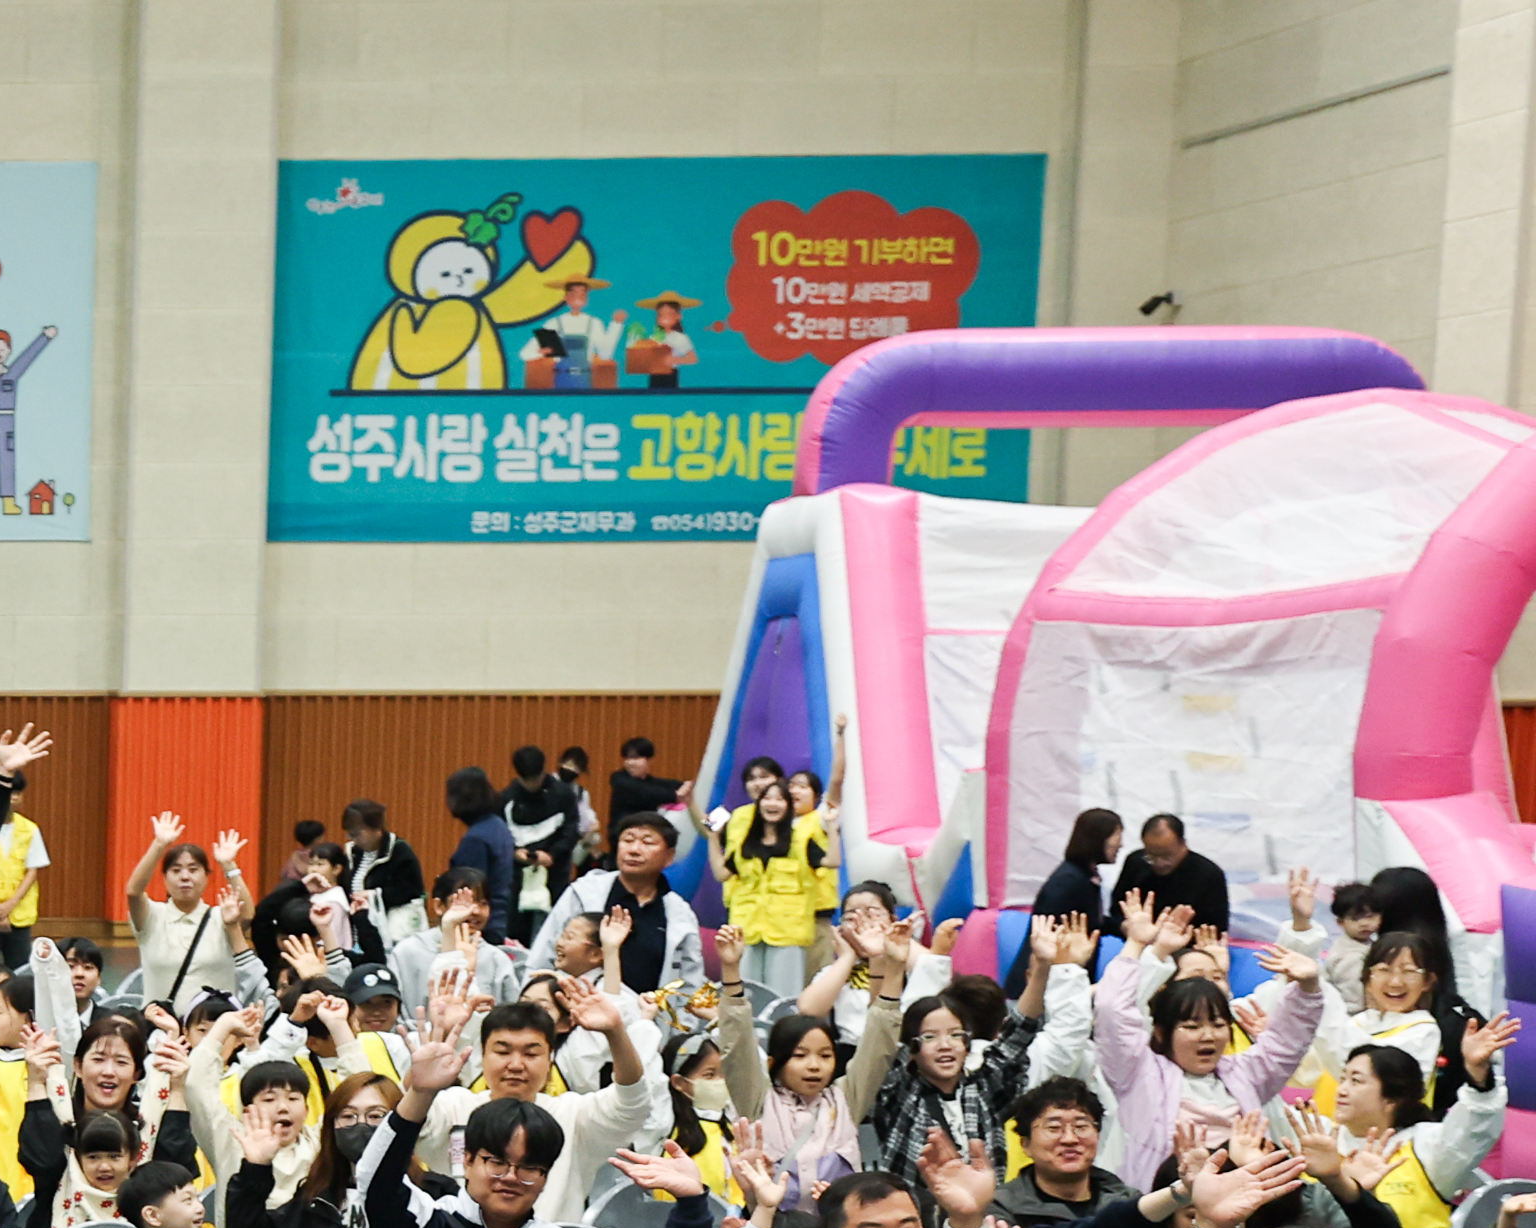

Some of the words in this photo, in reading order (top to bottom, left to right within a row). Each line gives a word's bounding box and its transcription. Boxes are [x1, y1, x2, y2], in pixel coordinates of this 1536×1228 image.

[751, 230, 848, 267] 10만원
[853, 236, 955, 265] 기부하면
[771, 276, 848, 305] 10만원
[306, 412, 489, 483] 성주사랑
[493, 412, 621, 482] 실천은
